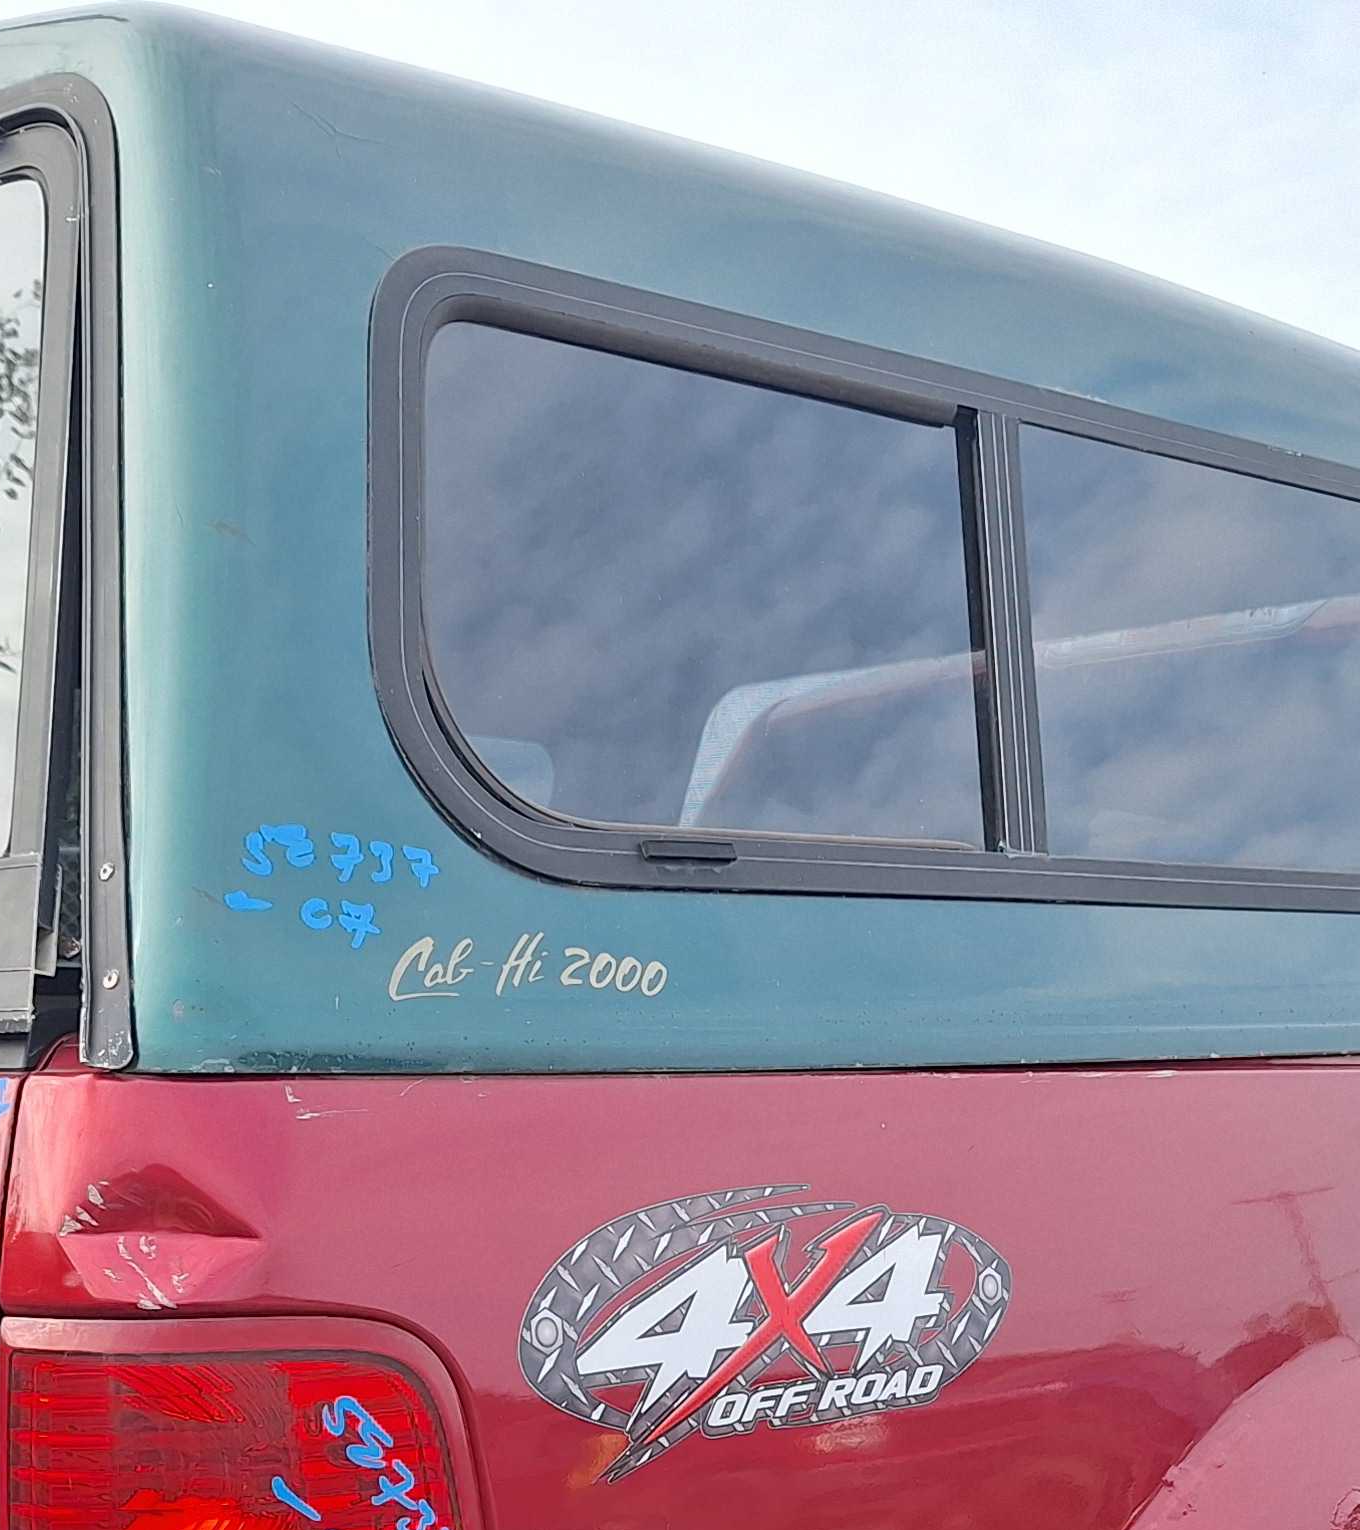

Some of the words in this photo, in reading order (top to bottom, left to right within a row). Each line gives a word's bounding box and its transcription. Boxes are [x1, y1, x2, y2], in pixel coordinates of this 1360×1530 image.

[559, 946, 669, 998] 2000
[706, 1384, 829, 1430] OFF
[826, 1363, 945, 1410] ROAD
